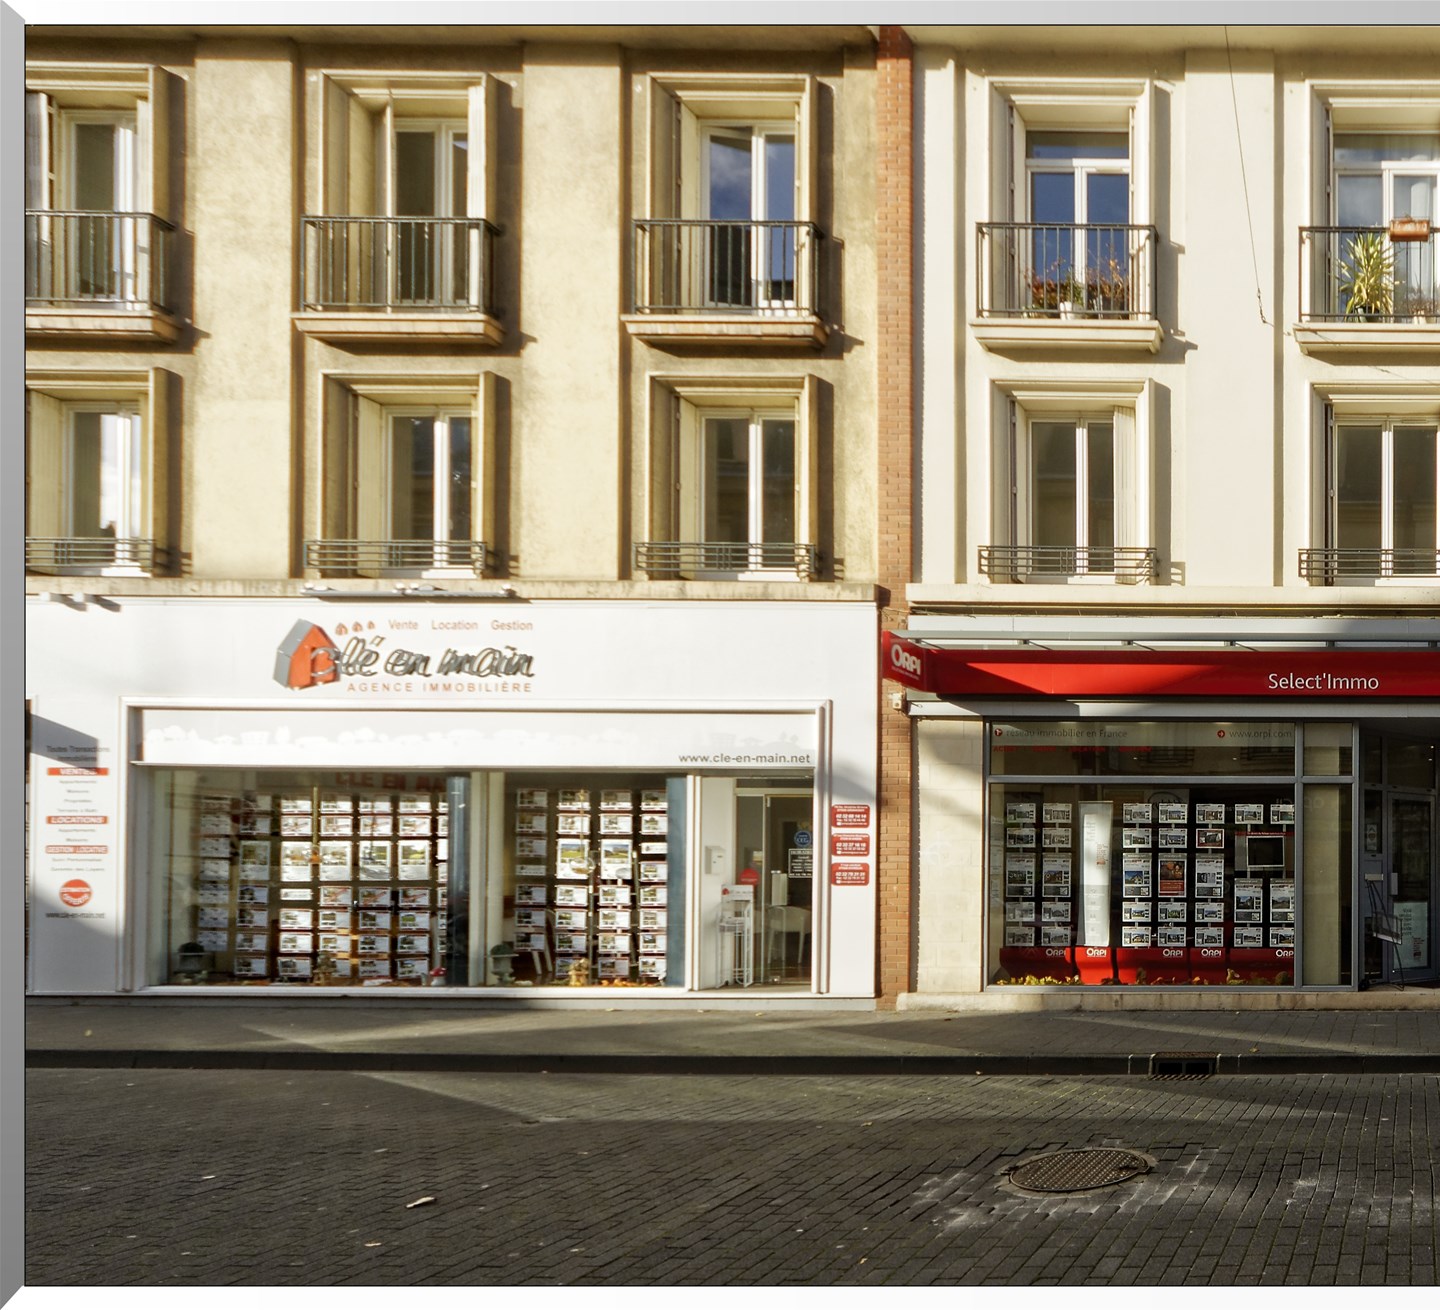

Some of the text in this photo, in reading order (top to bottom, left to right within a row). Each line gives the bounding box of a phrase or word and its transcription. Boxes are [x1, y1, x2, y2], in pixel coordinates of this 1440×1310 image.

[388, 620, 419, 630] Vente
[432, 620, 479, 630] Location
[490, 620, 533, 630] Gestion
[891, 643, 922, 676] ORPI
[347, 680, 532, 692] AGENCE IMMOBILIÈRE
[1268, 672, 1379, 690] Select'Immo
[1038, 728, 1084, 738] immobilier
[1086, 730, 1097, 738] en
[1100, 729, 1128, 738] France
[1229, 729, 1292, 740] www.orpi.com
[678, 752, 811, 764] www.cle-en-main.net
[1086, 948, 1106, 957] ORPI
[1162, 948, 1183, 957] ORPI
[1201, 948, 1222, 957] ORPI
[1276, 949, 1294, 957] ORP
